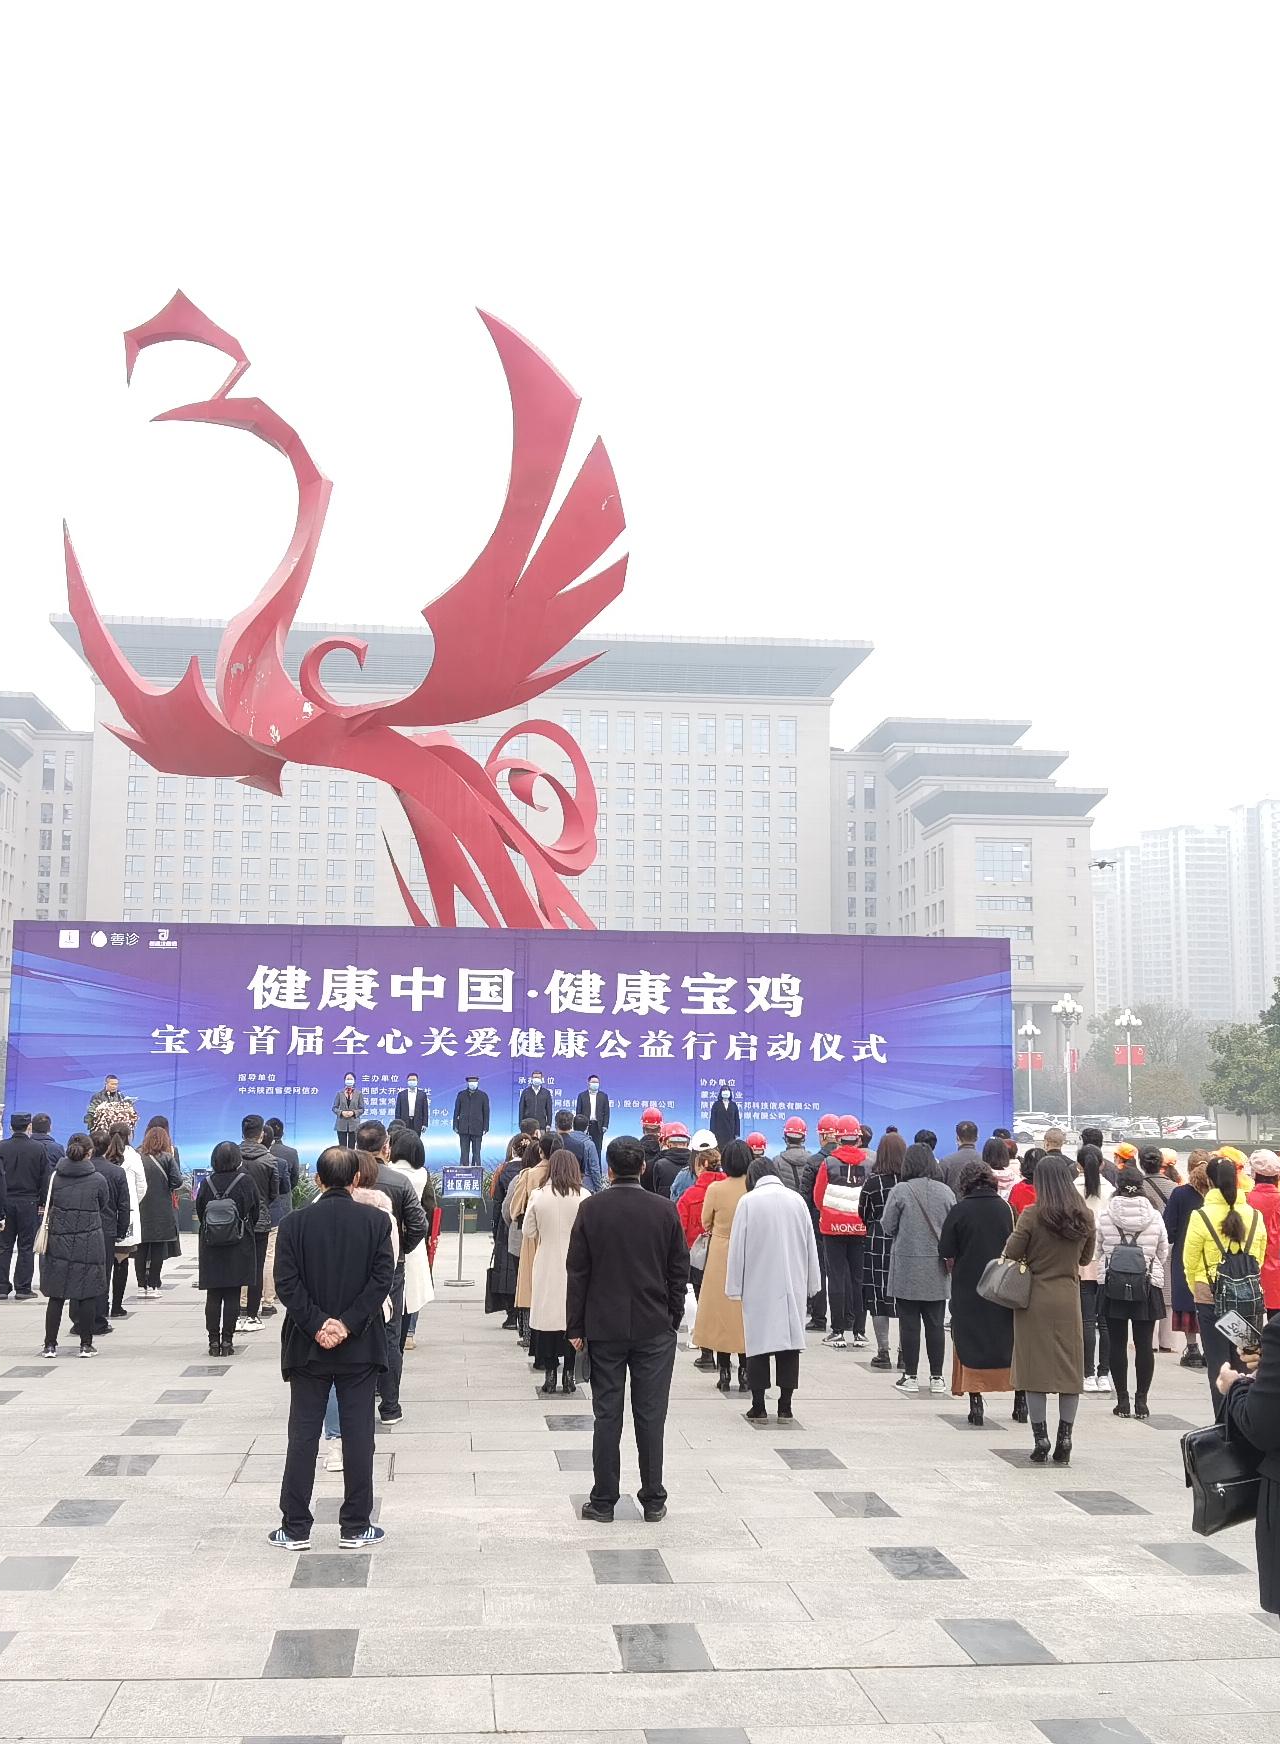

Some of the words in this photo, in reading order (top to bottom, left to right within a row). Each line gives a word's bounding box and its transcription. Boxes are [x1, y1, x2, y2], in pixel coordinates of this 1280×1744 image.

[110, 932, 140, 946] 善诊
[247, 965, 804, 1017] 健康中国·健康宝鸡
[150, 1023, 888, 1064] 宝鸡首届全心关爱健康公益行启动仪式
[238, 1074, 276, 1082] 指导单位
[361, 1075, 400, 1083] 主办单位
[238, 1086, 319, 1095] 中共陕西省委网信办
[446, 1179, 480, 1191] 社区居民
